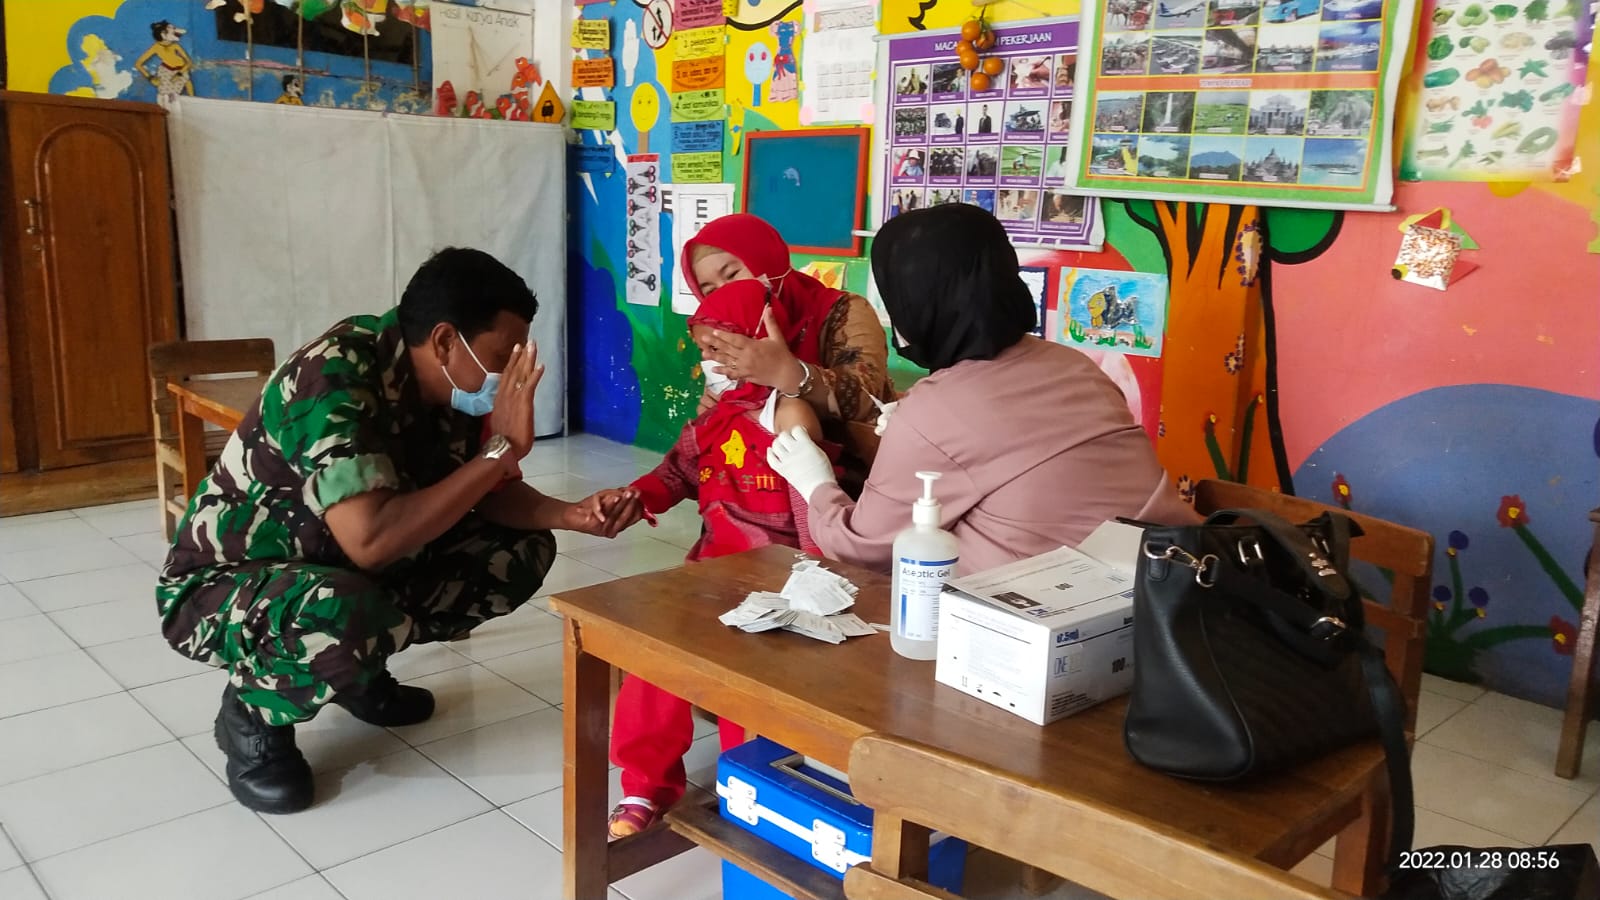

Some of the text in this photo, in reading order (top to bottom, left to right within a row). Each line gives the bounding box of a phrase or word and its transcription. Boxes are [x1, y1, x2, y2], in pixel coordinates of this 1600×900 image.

[495, 14, 519, 28] Anak
[934, 41, 961, 51] MACA
[1000, 32, 1052, 46] PEKERJAAN
[696, 199, 708, 218] E
[902, 567, 951, 579] Aseptic Gel
[1112, 657, 1127, 674] 100
